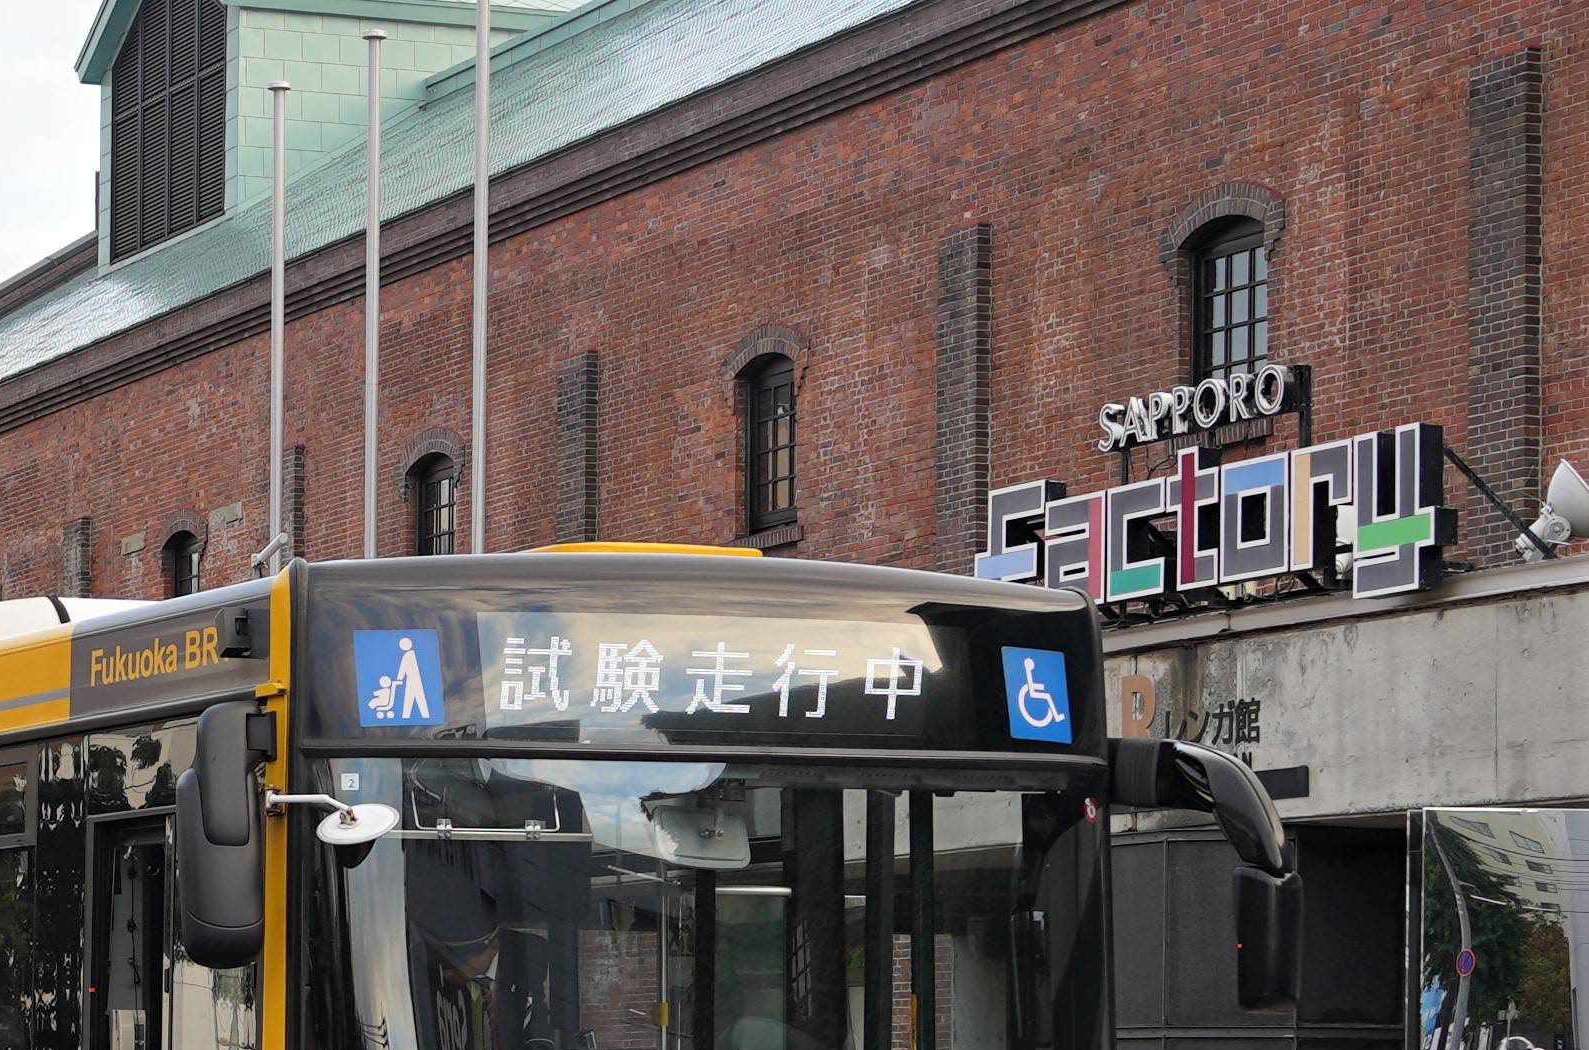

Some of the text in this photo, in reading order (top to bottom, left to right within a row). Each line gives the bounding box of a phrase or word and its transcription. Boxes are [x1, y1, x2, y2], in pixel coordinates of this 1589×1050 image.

[1098, 364, 1288, 453] SAPPORO
[90, 626, 230, 688] Fukuoka BR
[499, 636, 924, 721] 試験走行中
